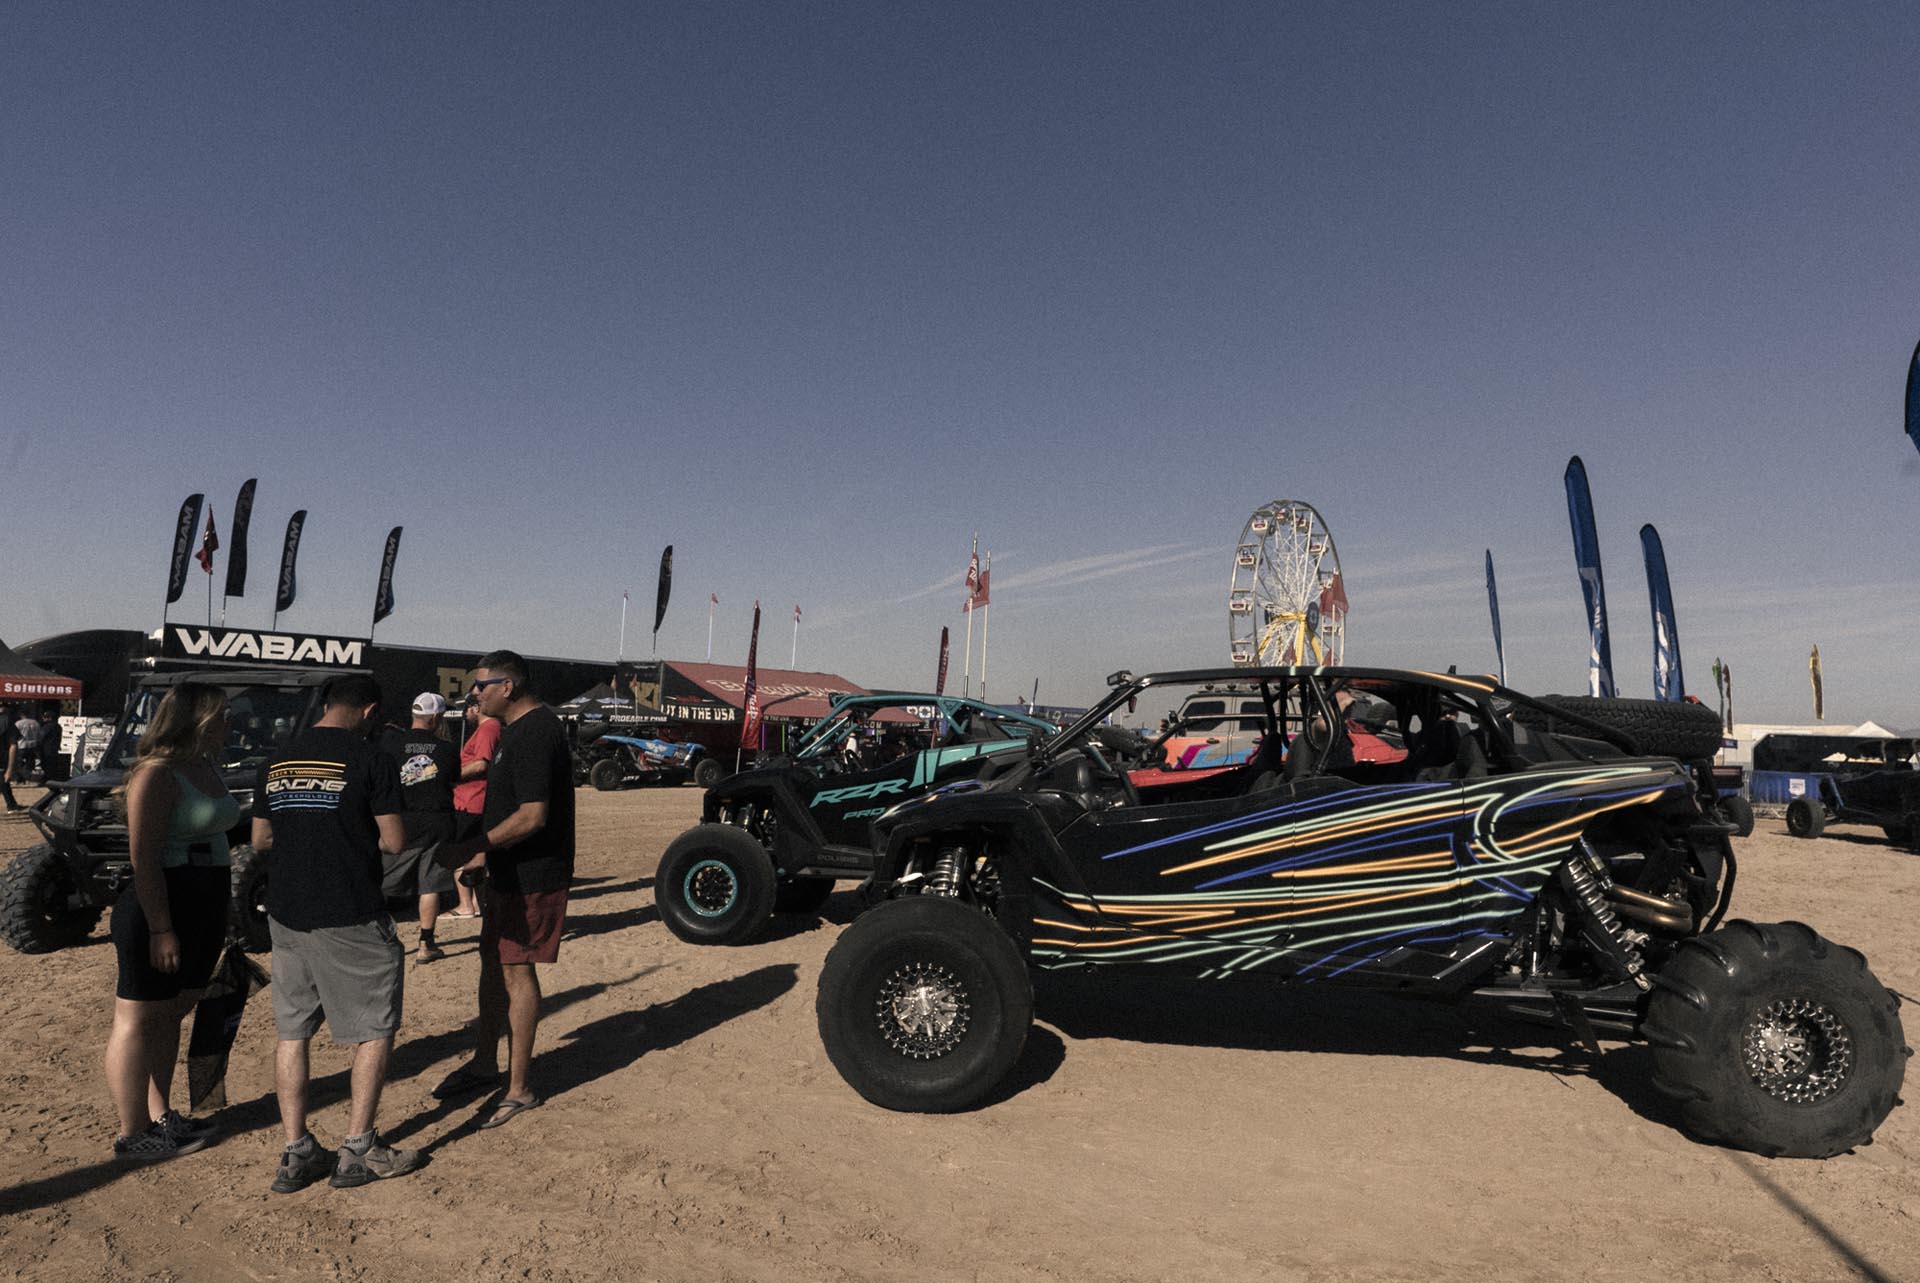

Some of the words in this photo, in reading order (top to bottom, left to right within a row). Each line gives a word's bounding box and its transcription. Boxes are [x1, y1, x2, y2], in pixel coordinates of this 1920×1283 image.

[173, 505, 194, 589] WABAM
[280, 520, 300, 599] WABAM
[175, 628, 362, 665] WABAM
[4, 682, 73, 694] Solutions
[678, 706, 689, 719] IN
[691, 706, 711, 721] THE
[713, 708, 736, 721] USA
[404, 743, 437, 754] STAFF
[265, 779, 348, 794] RACING
[809, 778, 909, 809] RZR
[842, 806, 887, 820] PRO
[816, 854, 859, 864] POLARIS
